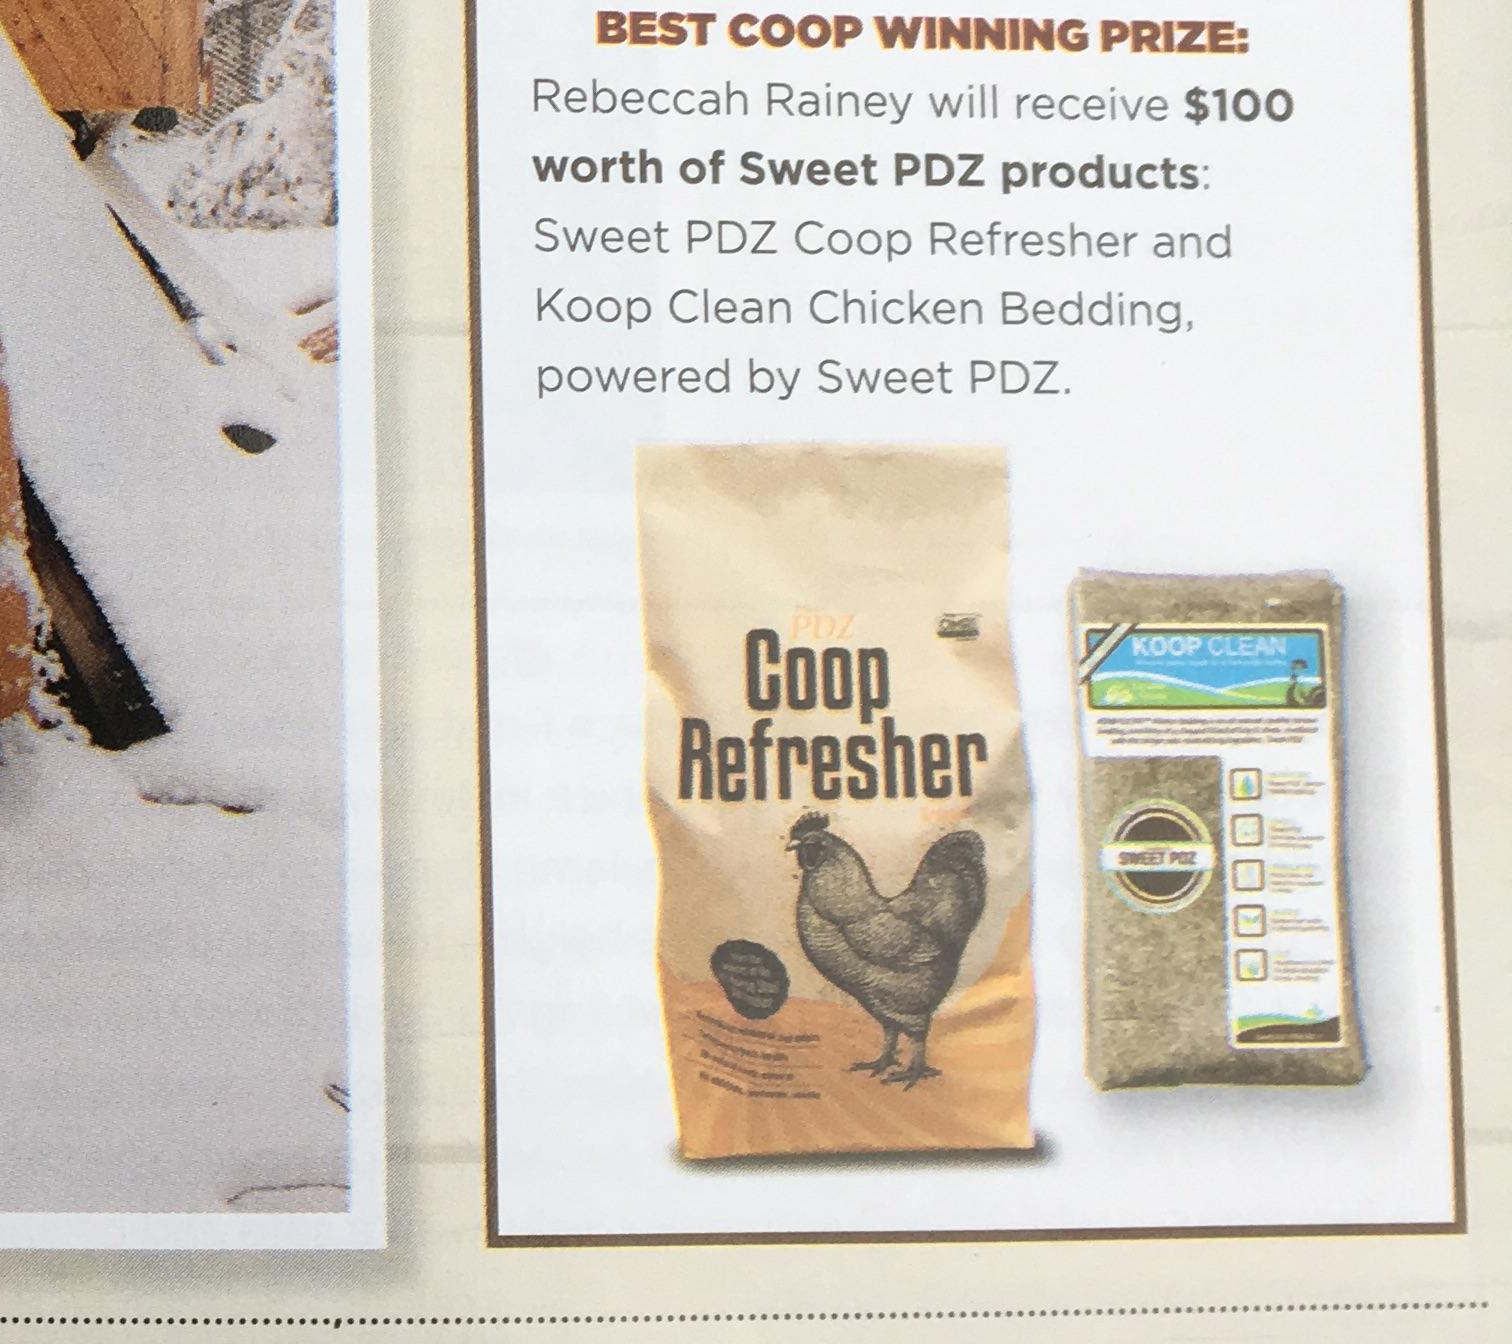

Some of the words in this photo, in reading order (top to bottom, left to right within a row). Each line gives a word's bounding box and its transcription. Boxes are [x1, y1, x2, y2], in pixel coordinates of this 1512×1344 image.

[597, 11, 716, 46] BEST
[729, 13, 863, 48] COOP
[874, 16, 1088, 52] WINNING
[1101, 20, 1249, 53] PRIZE:
[533, 78, 748, 115] Rebeccah
[767, 82, 913, 124] Rainey
[929, 84, 998, 118] will
[1016, 87, 1168, 121] receive
[1185, 86, 1294, 126] $100
[532, 149, 663, 184] worth
[679, 149, 725, 184] of
[740, 151, 877, 186] Sweet
[895, 153, 985, 187] PDZ
[1002, 154, 1209, 194] products:
[535, 218, 670, 254] Sweet
[687, 220, 778, 254] PDZ
[795, 220, 912, 262] Coop
[930, 221, 1138, 258] Refresher
[1153, 224, 1231, 259] and
[537, 288, 651, 330] Koop
[669, 288, 791, 324] Clean
[809, 289, 983, 325] Chicken
[1001, 291, 1193, 334] Bedding,
[538, 358, 730, 399] powered
[749, 358, 801, 400] by
[818, 359, 953, 394] Sweet
[970, 360, 1070, 394] PDZ.
[1132, 636, 1202, 656] KOOP
[1208, 636, 1286, 656] CLEAN
[745, 628, 892, 724] Coop
[678, 717, 988, 802] Refresher
